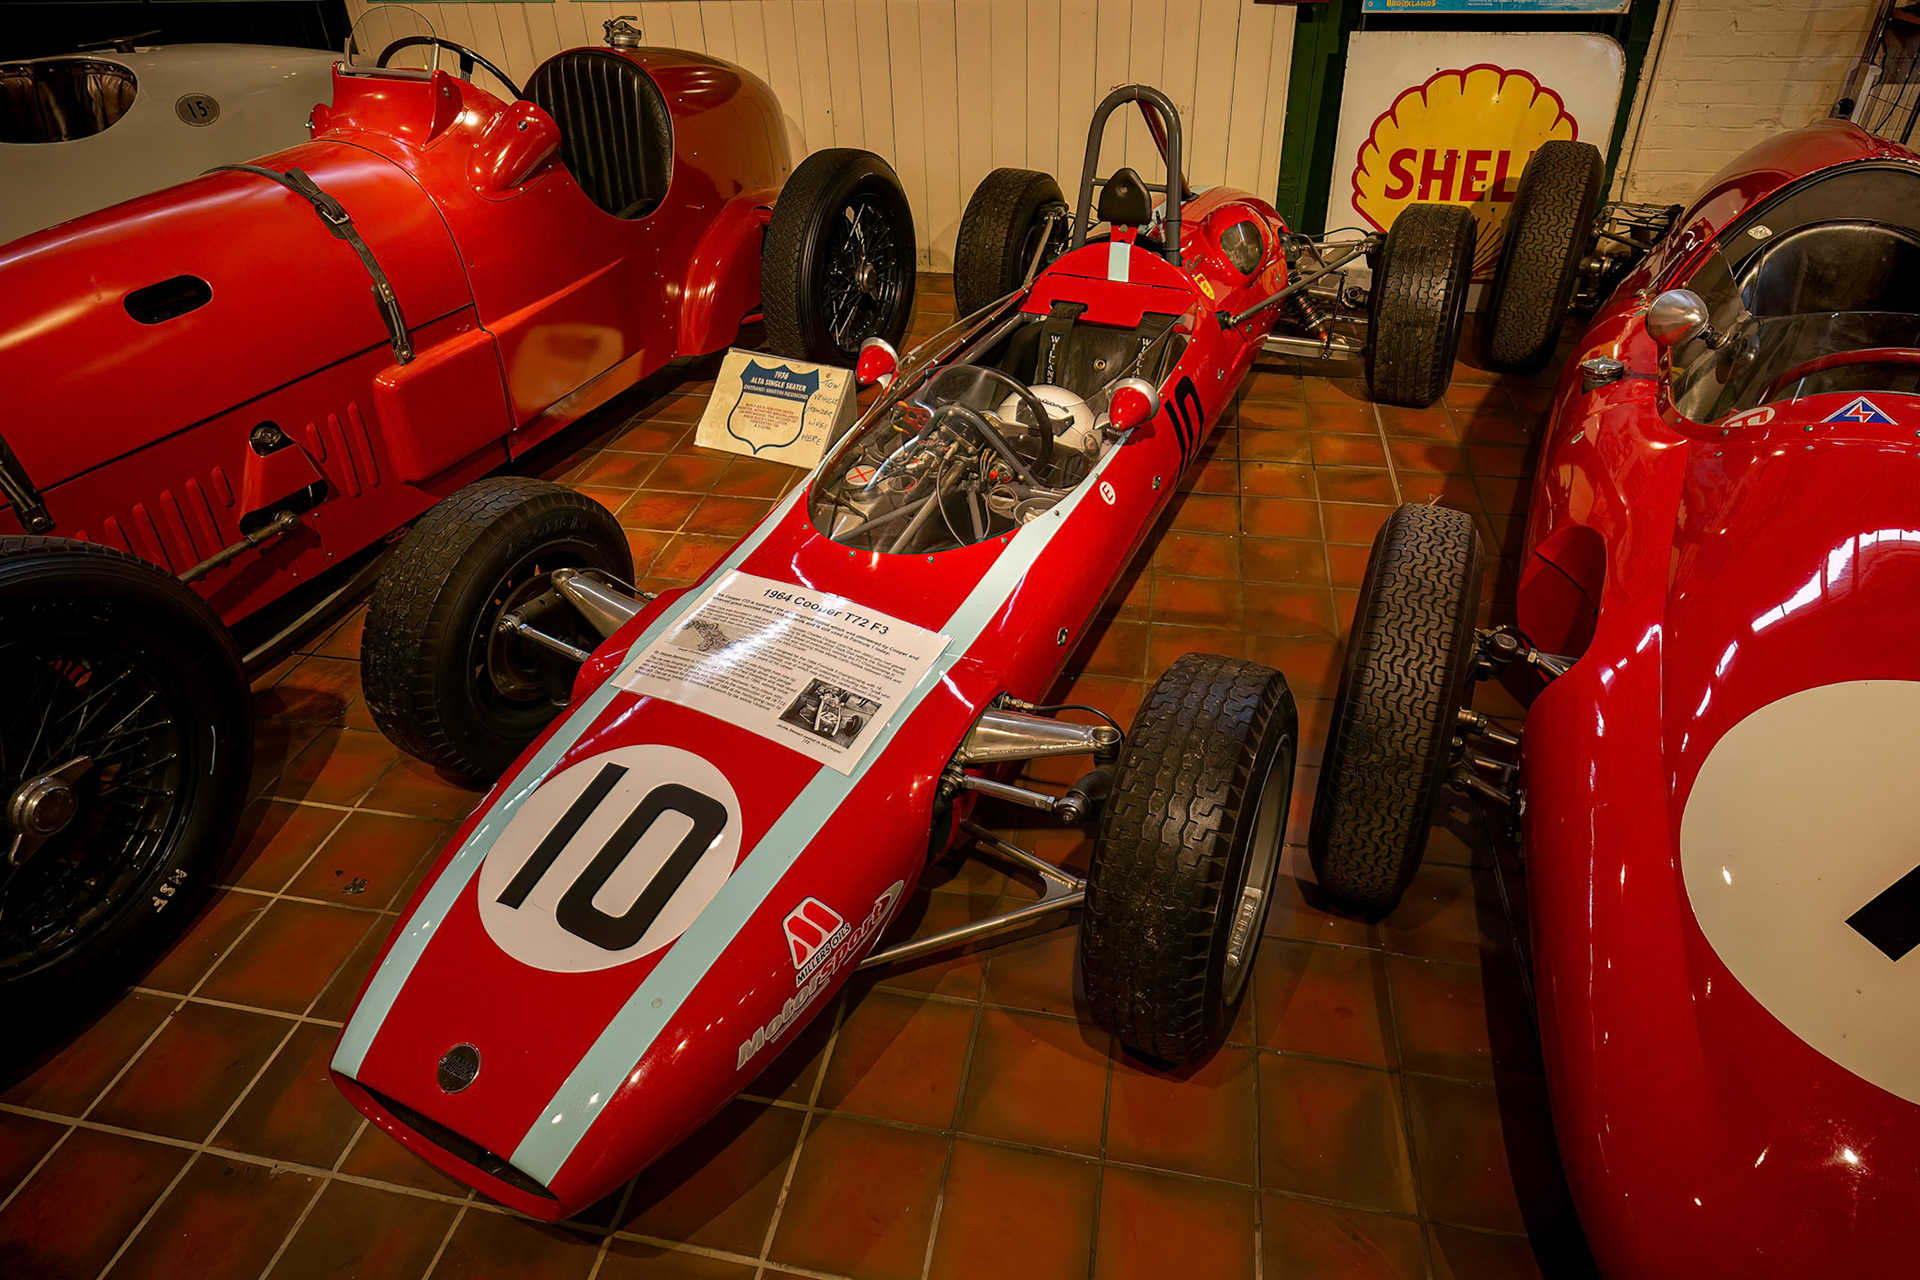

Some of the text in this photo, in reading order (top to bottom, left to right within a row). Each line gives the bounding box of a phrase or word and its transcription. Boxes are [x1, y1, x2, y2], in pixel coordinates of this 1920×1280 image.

[187, 100, 208, 119] 15
[1384, 148, 1535, 202] SHEL
[1046, 335, 1062, 385] WILLANS
[765, 380, 786, 388] SINGLE
[786, 383, 807, 392] SEATER
[785, 392, 809, 400] REDMOND
[801, 433, 821, 446] HERE
[1164, 375, 1204, 483] 10
[763, 589, 889, 635] 1964 Cooper T72 F3
[495, 762, 728, 951] 10
[796, 922, 852, 986] MILLERS OILS
[737, 900, 886, 1070] Motorsport
